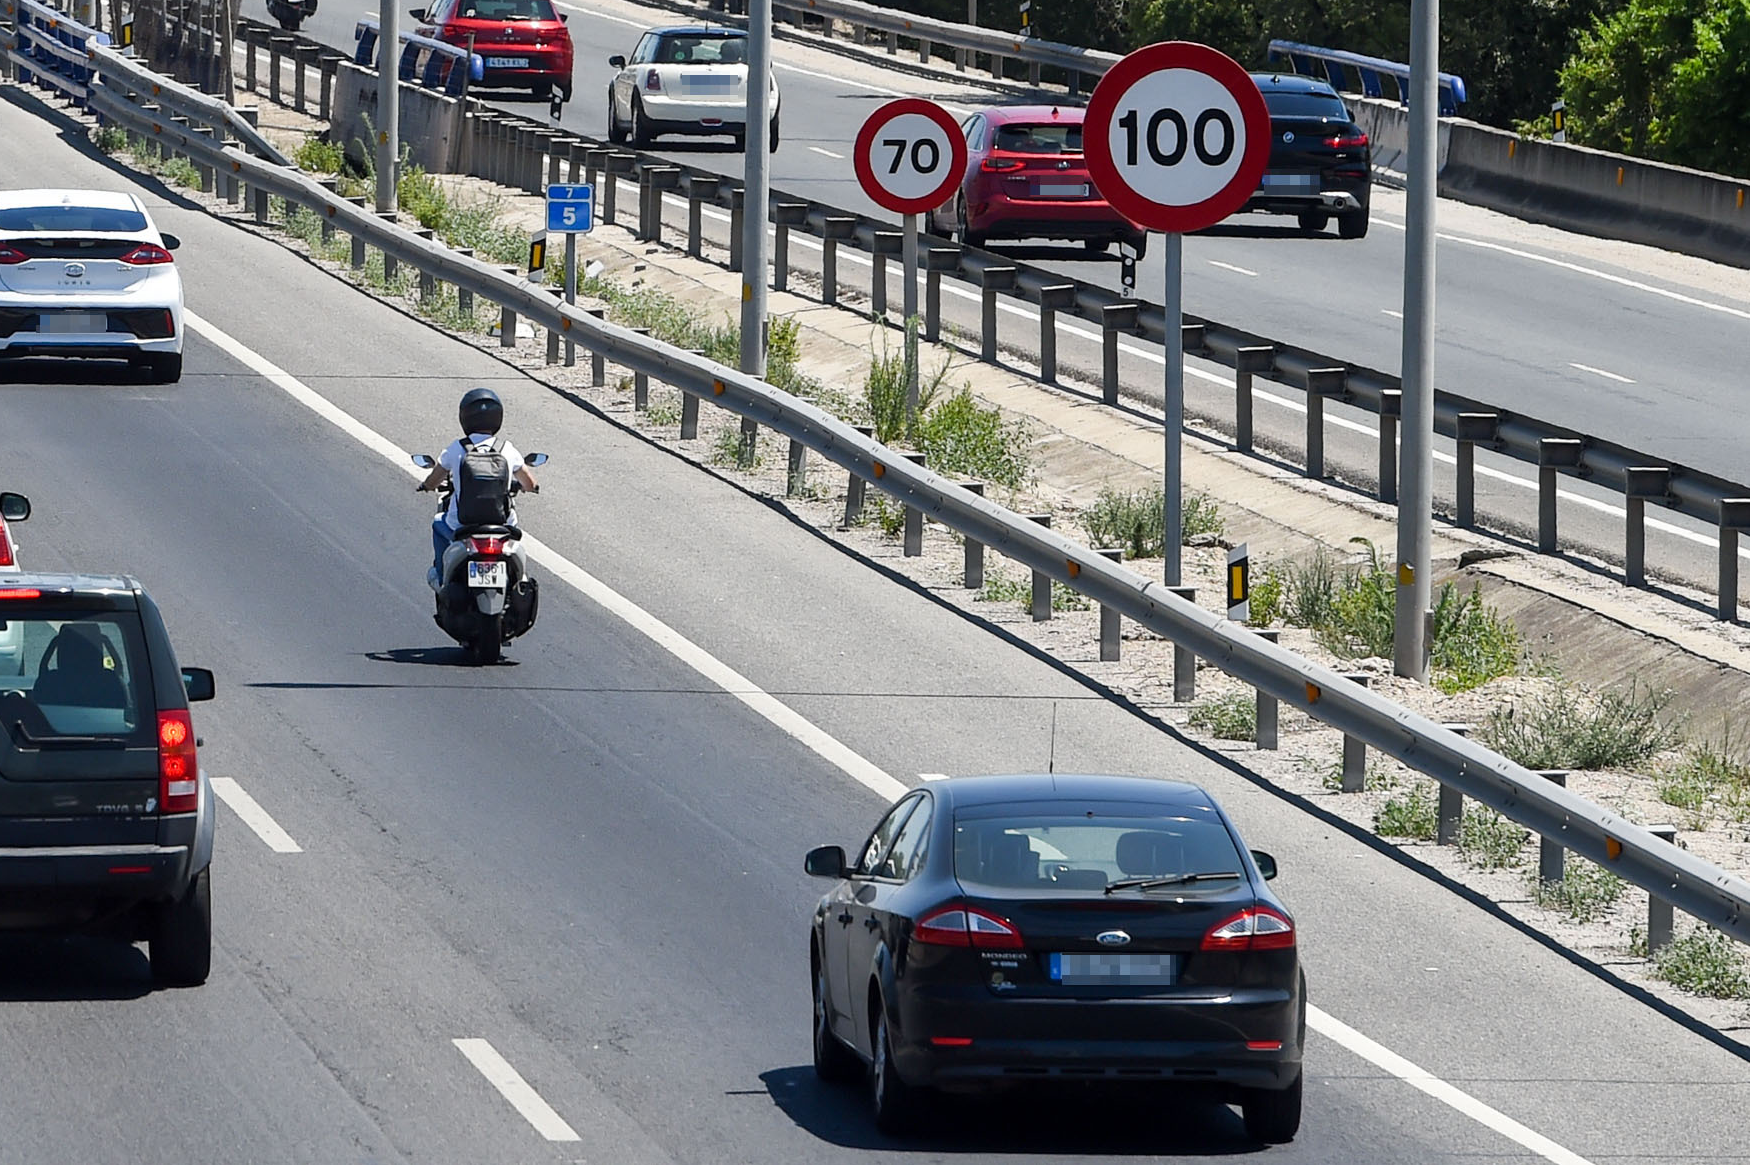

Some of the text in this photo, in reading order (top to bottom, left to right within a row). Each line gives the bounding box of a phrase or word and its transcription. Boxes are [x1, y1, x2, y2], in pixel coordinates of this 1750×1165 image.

[1118, 107, 1235, 167] 100
[883, 138, 940, 174] 70
[565, 187, 573, 199] 7
[562, 207, 576, 225] 5
[1123, 286, 1129, 297] 5
[477, 563, 504, 574] 6361
[478, 575, 498, 585] JSW
